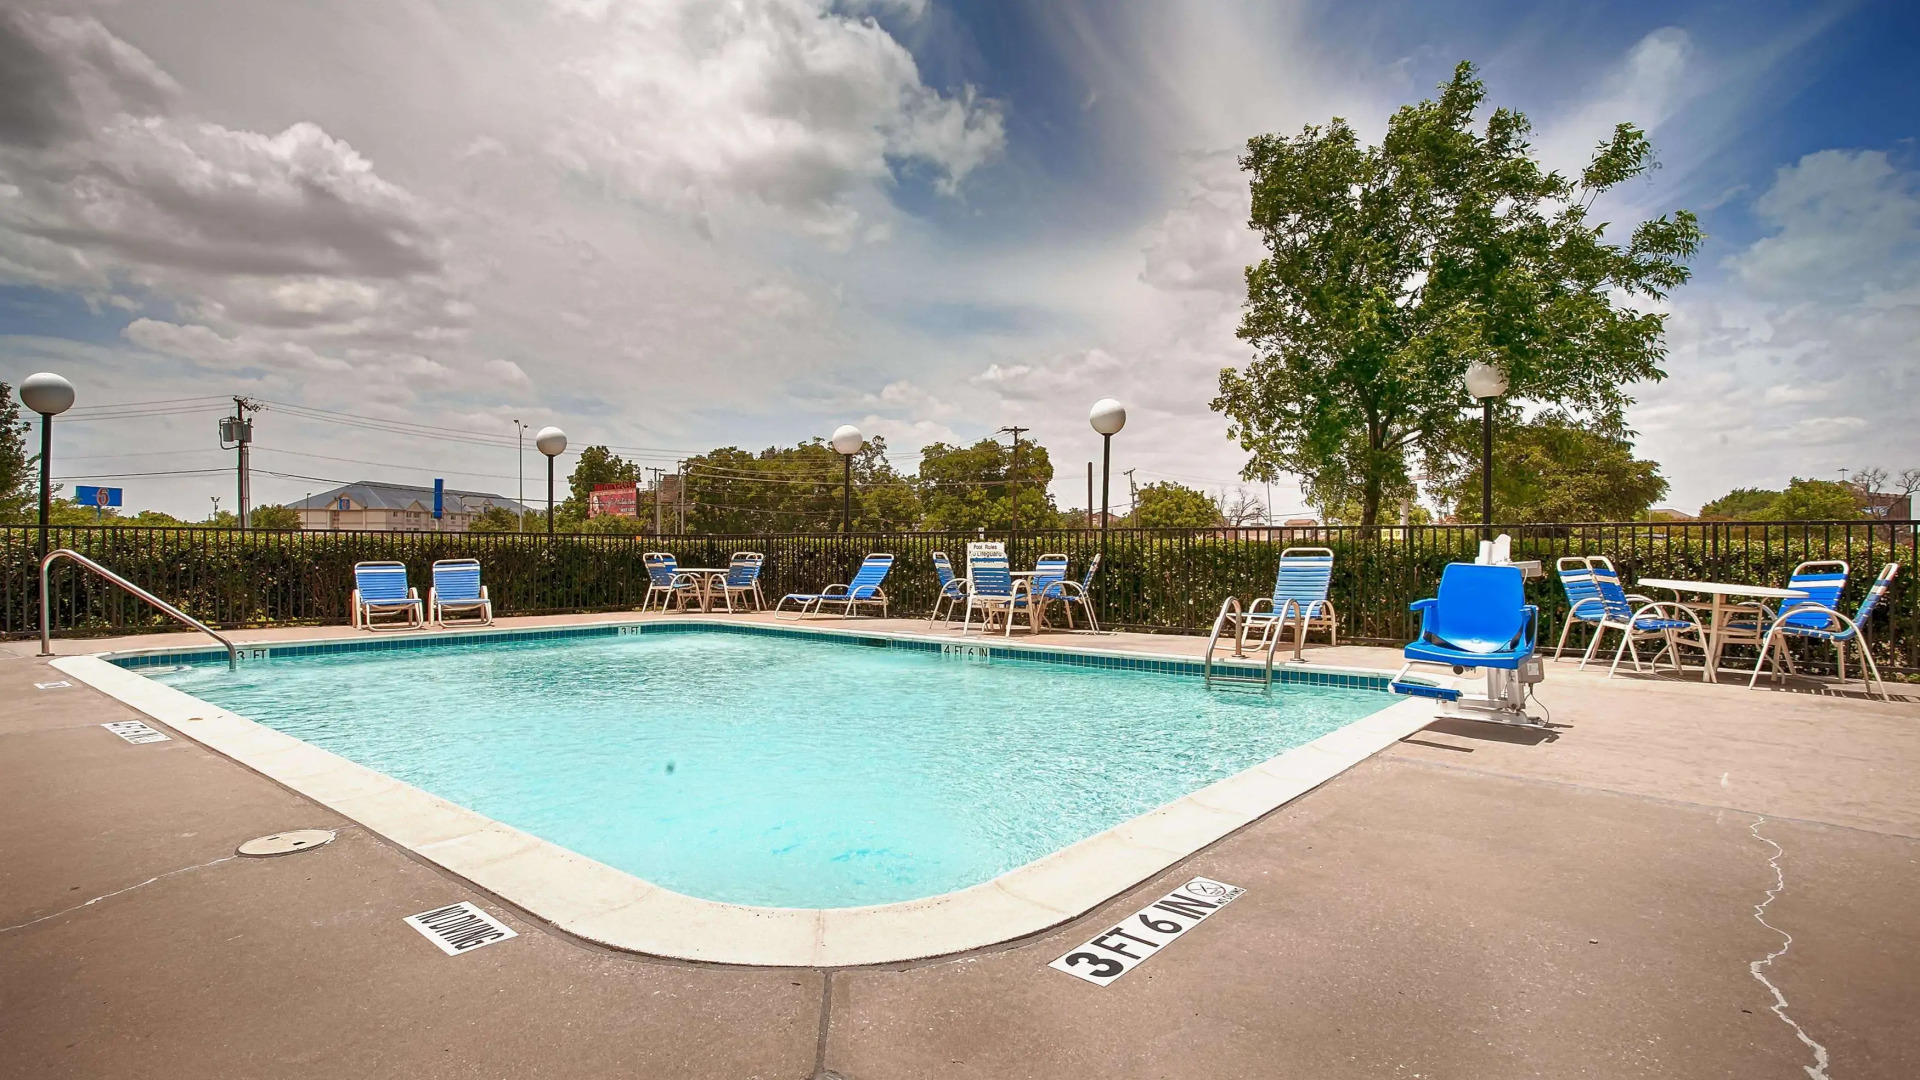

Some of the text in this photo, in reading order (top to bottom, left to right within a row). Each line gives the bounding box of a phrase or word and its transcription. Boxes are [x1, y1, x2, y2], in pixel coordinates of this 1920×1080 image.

[96, 487, 110, 506] 6
[631, 626, 639, 636] FT
[236, 649, 267, 661] 3 FT
[955, 645, 963, 656] FT
[979, 647, 988, 658] IN
[415, 904, 505, 951] NO DIVING
[1065, 893, 1219, 978] 3 FT 6 IN
